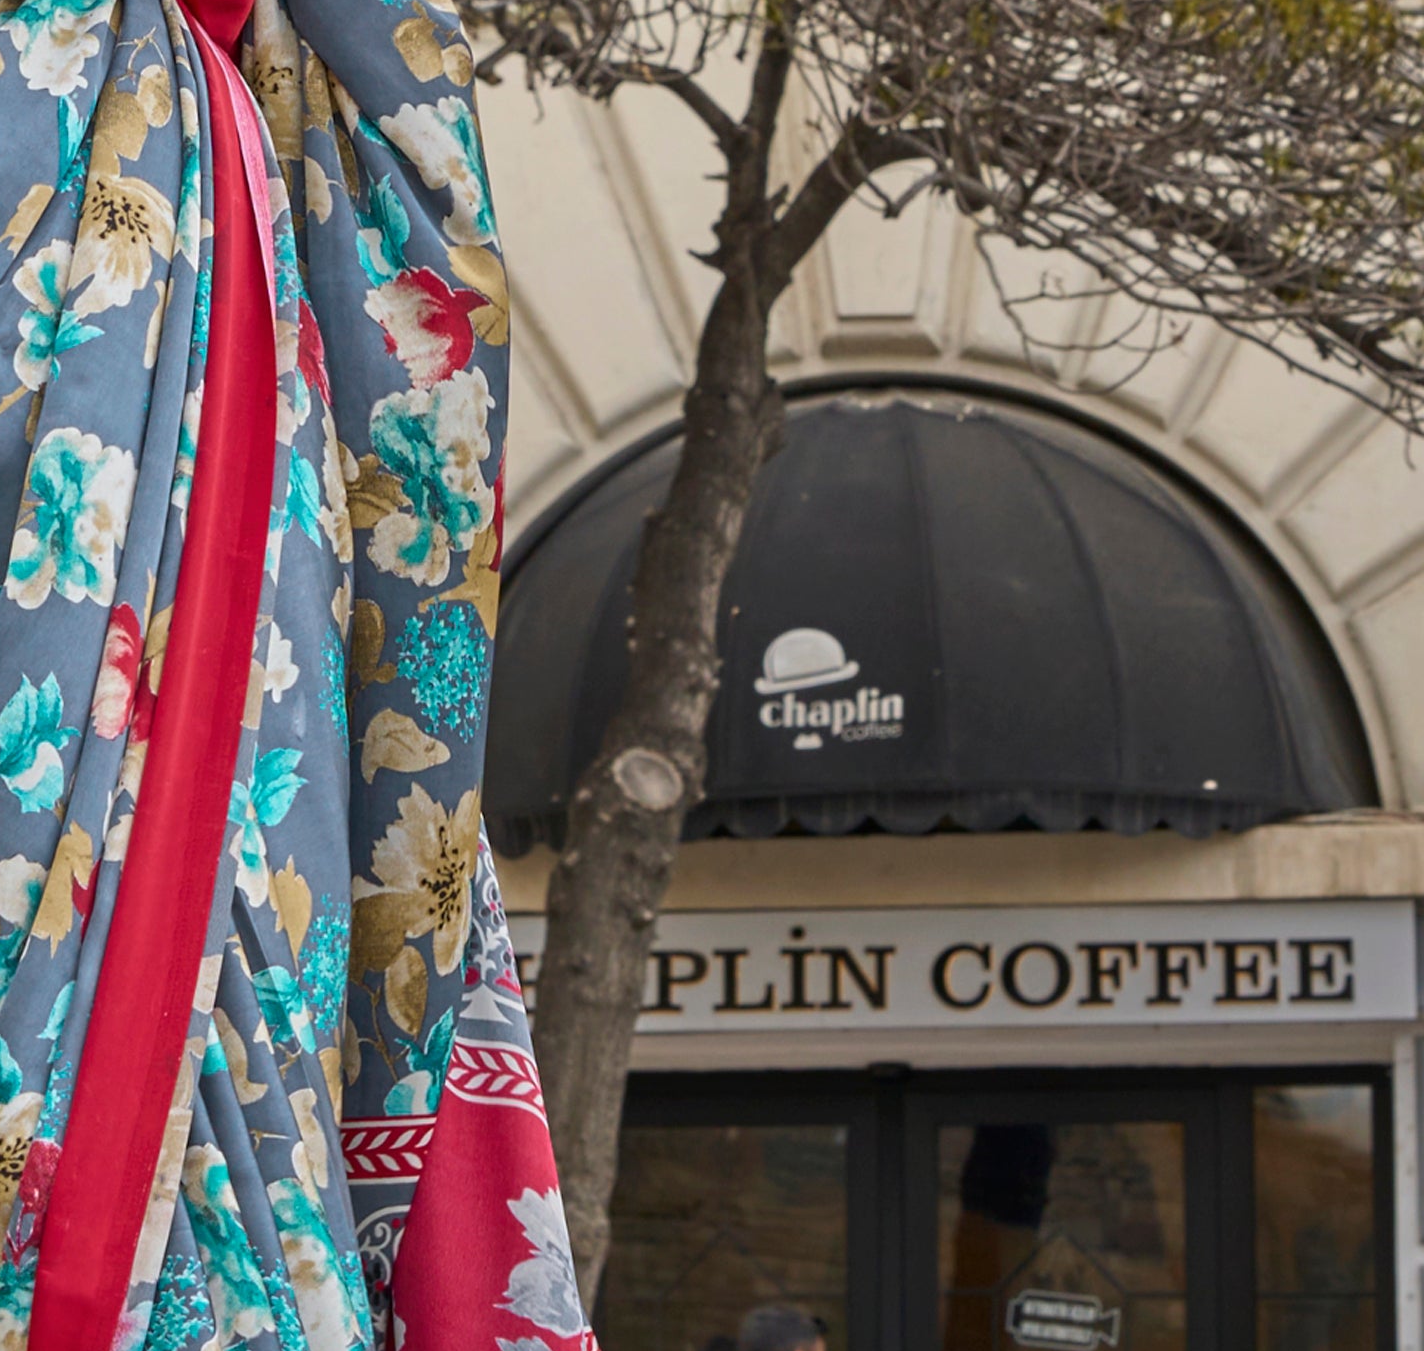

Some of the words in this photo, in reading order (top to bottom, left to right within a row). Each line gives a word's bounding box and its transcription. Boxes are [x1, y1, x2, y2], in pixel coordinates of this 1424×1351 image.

[760, 687, 904, 736] chaplin
[516, 926, 897, 1013] PLİN
[931, 937, 1355, 1010] COFFEE
